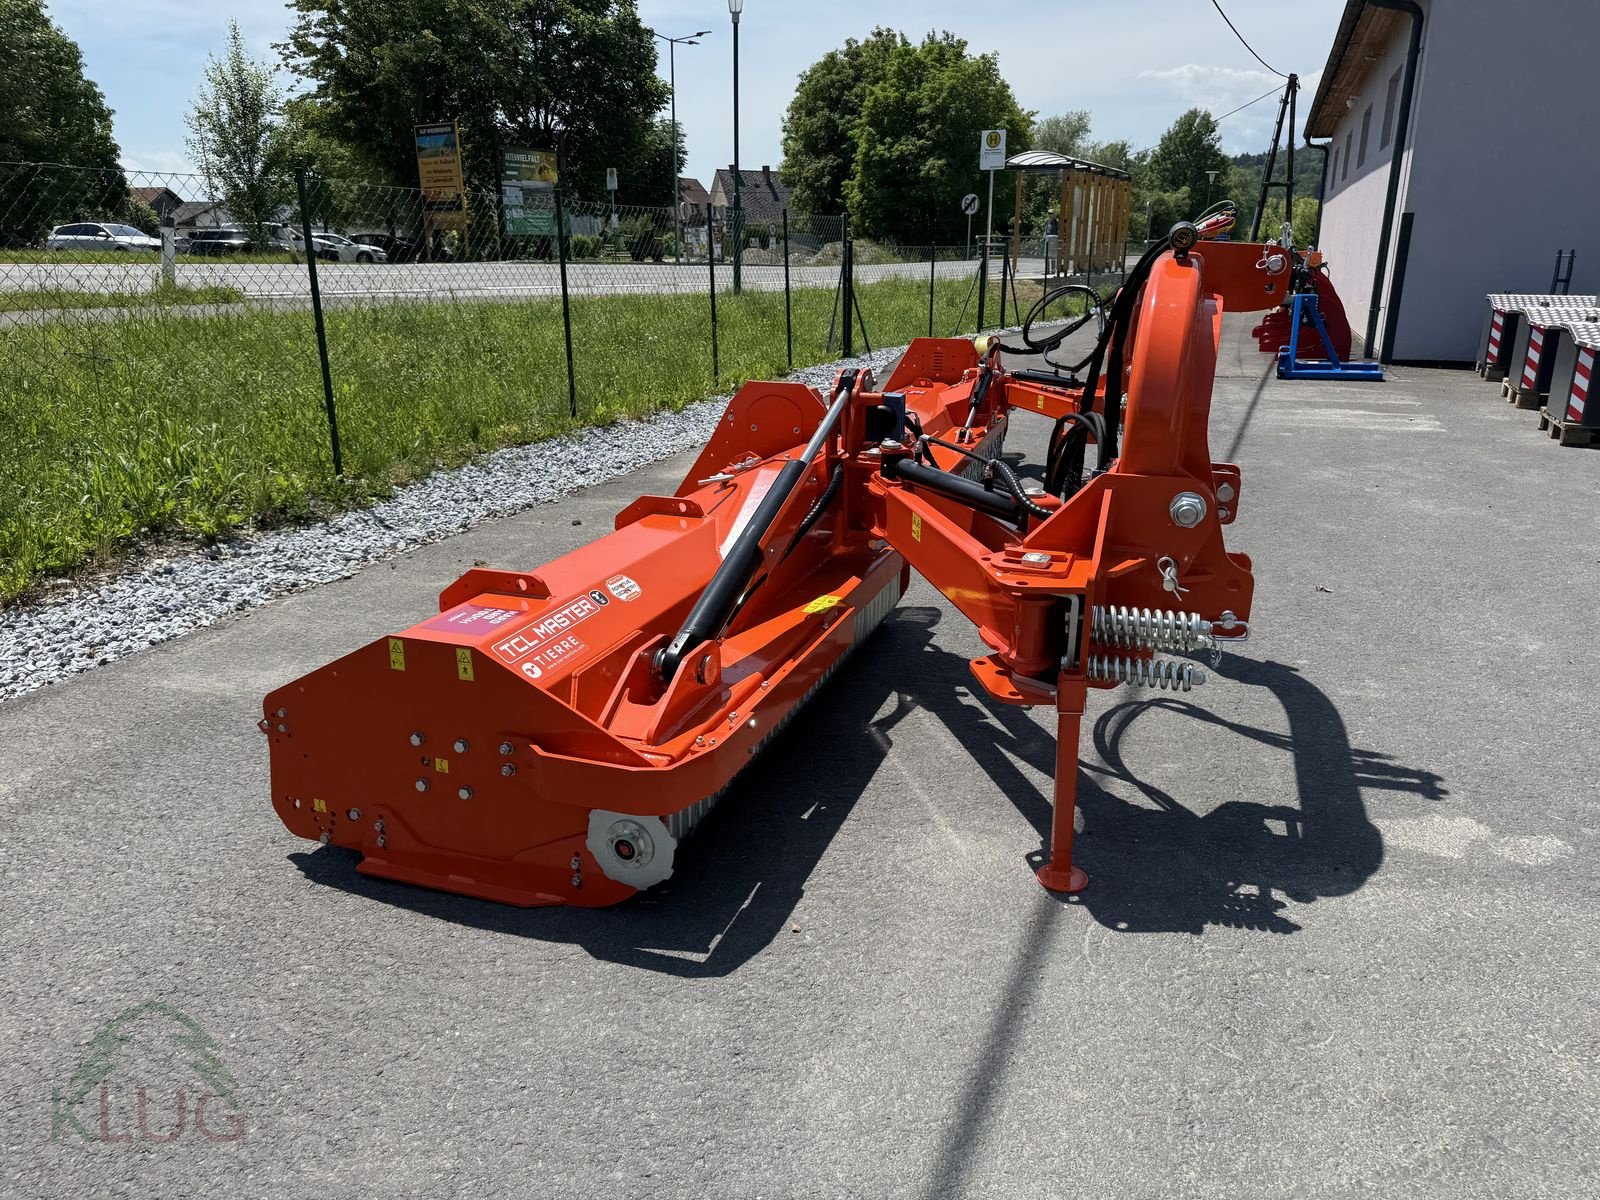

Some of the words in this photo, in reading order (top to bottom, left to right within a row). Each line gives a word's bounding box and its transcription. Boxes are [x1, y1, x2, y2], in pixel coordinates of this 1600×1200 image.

[498, 635, 540, 657] TCL
[533, 598, 596, 640] MASTER
[533, 635, 579, 666] TIERRE
